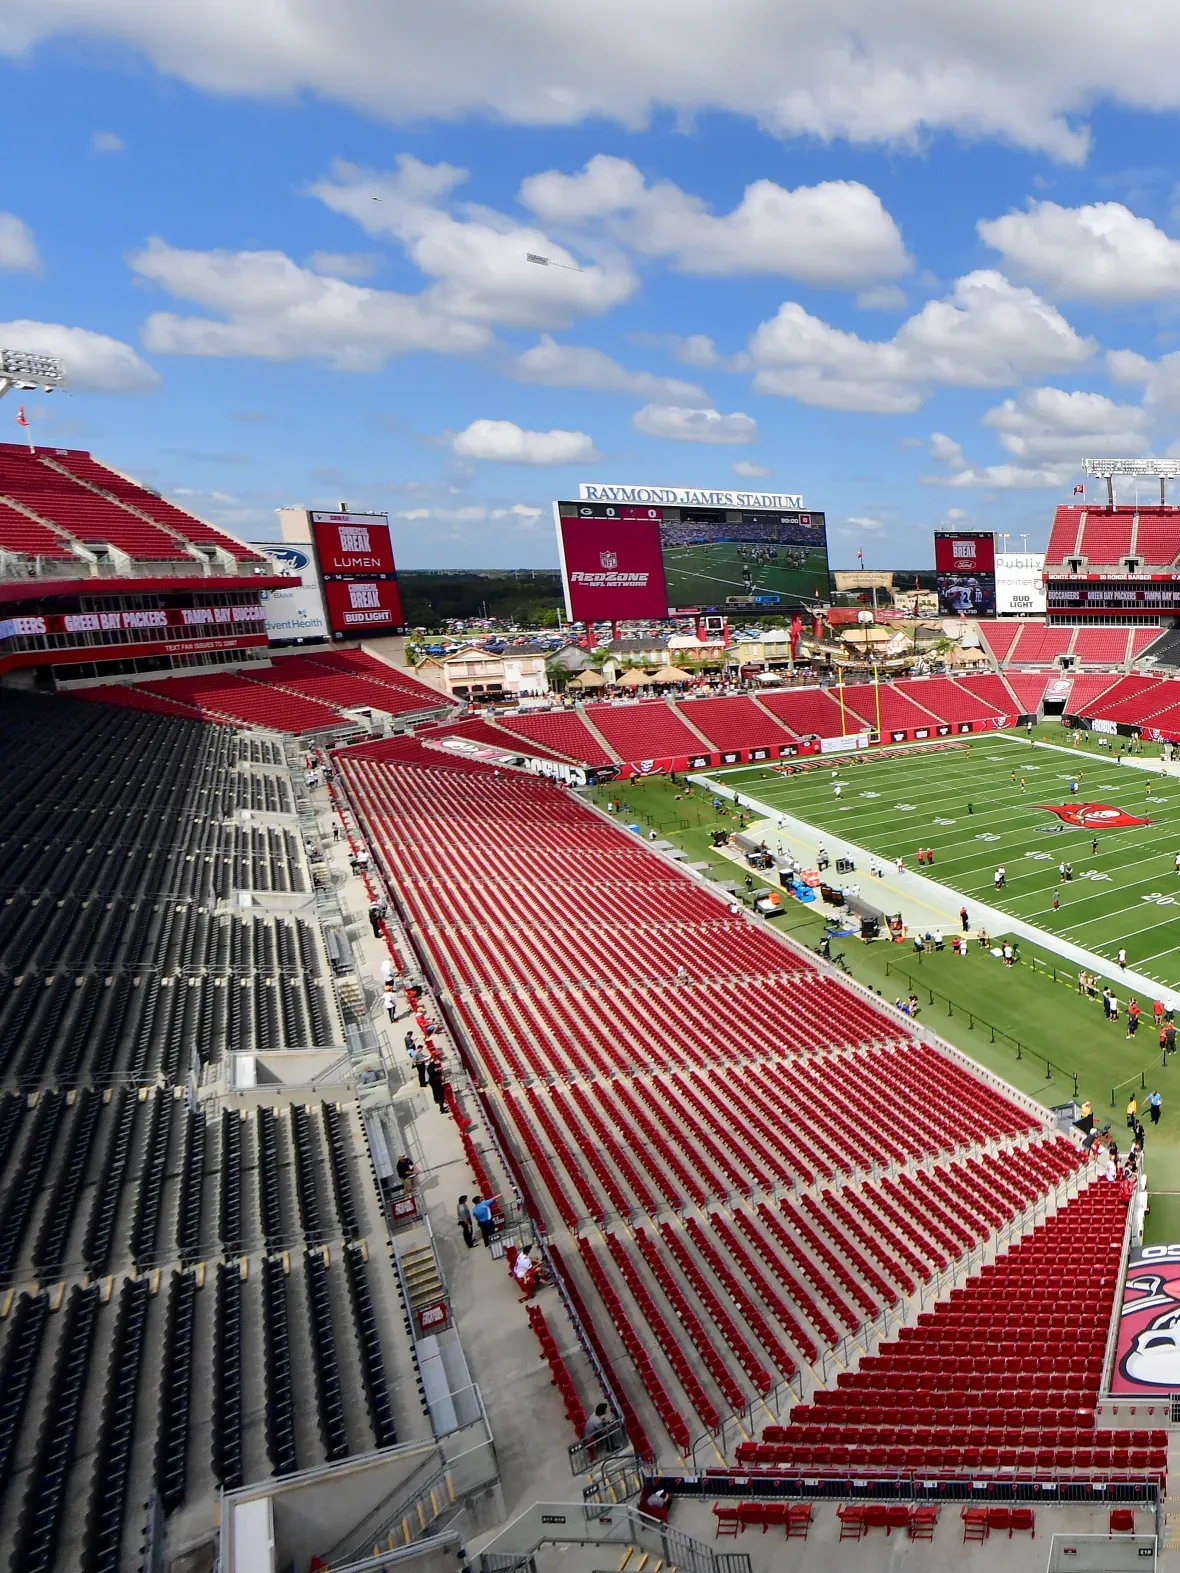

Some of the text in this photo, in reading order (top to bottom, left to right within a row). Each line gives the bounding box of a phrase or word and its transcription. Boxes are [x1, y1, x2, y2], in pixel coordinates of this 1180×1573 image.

[585, 486, 801, 509] RAYMOND JAMES STADIUM
[606, 508, 616, 516] 0
[648, 509, 656, 518] 0
[340, 535, 372, 552] BREAK
[953, 546, 976, 558] BREAK
[334, 558, 381, 567] LUMEN
[996, 558, 1042, 569] Publix
[350, 590, 381, 608] BREAK
[1048, 591, 1080, 600] BUCCANEERS
[1088, 592, 1103, 600] GREEN
[1104, 592, 1113, 600] BAY
[1114, 592, 1136, 600] PACKERS
[1144, 592, 1160, 600] TAMPA
[1162, 592, 1172, 600] BAY
[64, 614, 100, 632] GREEN
[100, 613, 122, 630] BAY
[122, 610, 168, 628] PACKERS
[181, 608, 214, 625] TAMPA
[214, 608, 232, 623] BAY
[345, 611, 390, 622] BUD LIGHT
[264, 618, 322, 631] dventHealth
[165, 644, 180, 652] TEXT
[194, 641, 214, 649] ISSUES
[214, 640, 223, 648] TO
[1092, 718, 1118, 736] #GOBUCS
[1079, 870, 1108, 881] 30
[1140, 892, 1176, 906] 20
